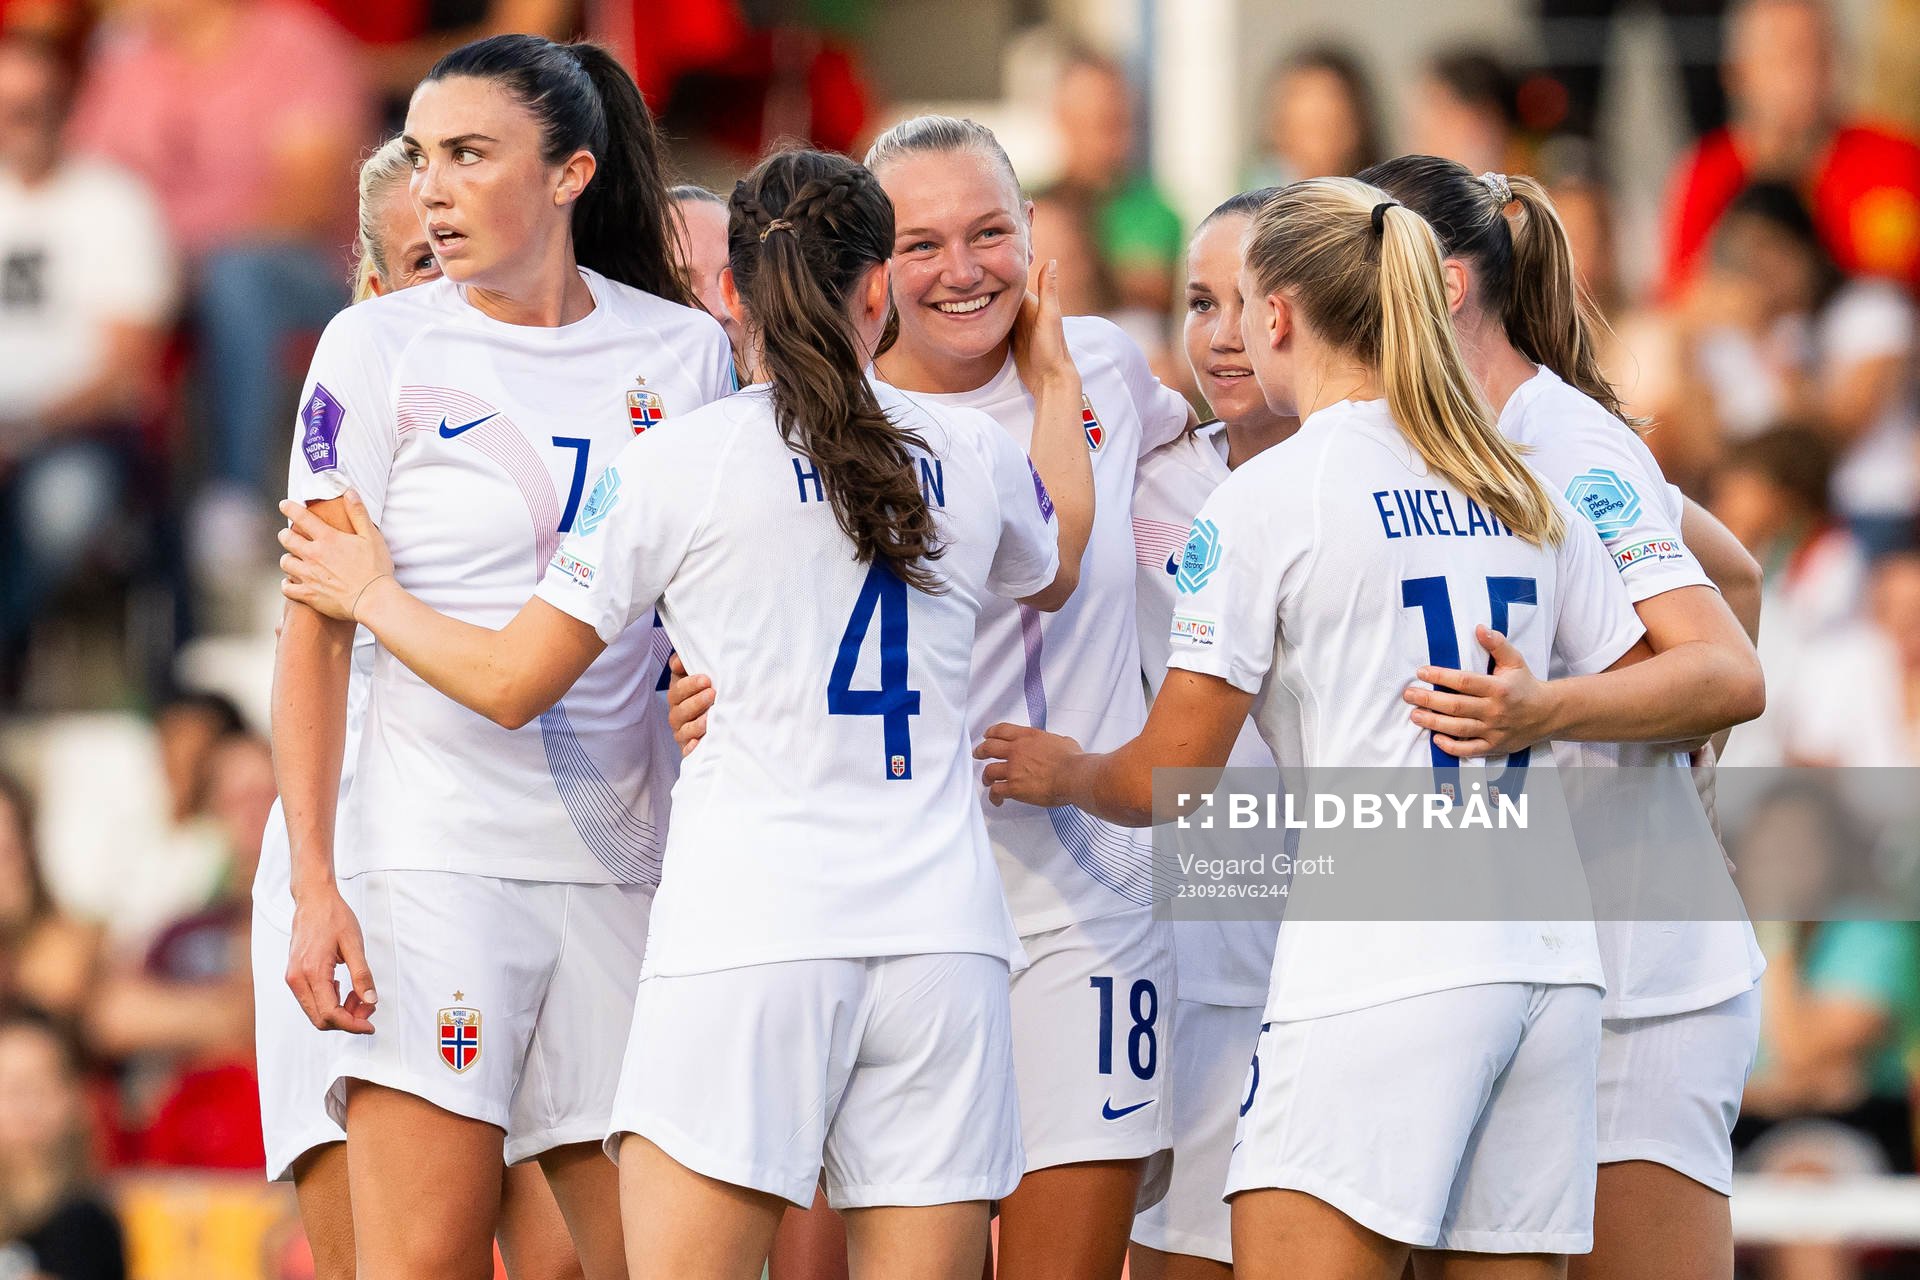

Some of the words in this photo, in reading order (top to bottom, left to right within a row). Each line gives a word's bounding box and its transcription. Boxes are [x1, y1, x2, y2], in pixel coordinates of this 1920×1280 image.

[552, 435, 591, 532] 7
[1583, 493, 1599, 504] We
[1593, 500, 1625, 519] Strong
[1188, 543, 1196, 551] We
[1614, 541, 1680, 569] UNDATION
[827, 554, 921, 781] 4
[1089, 976, 1158, 1081] 18
